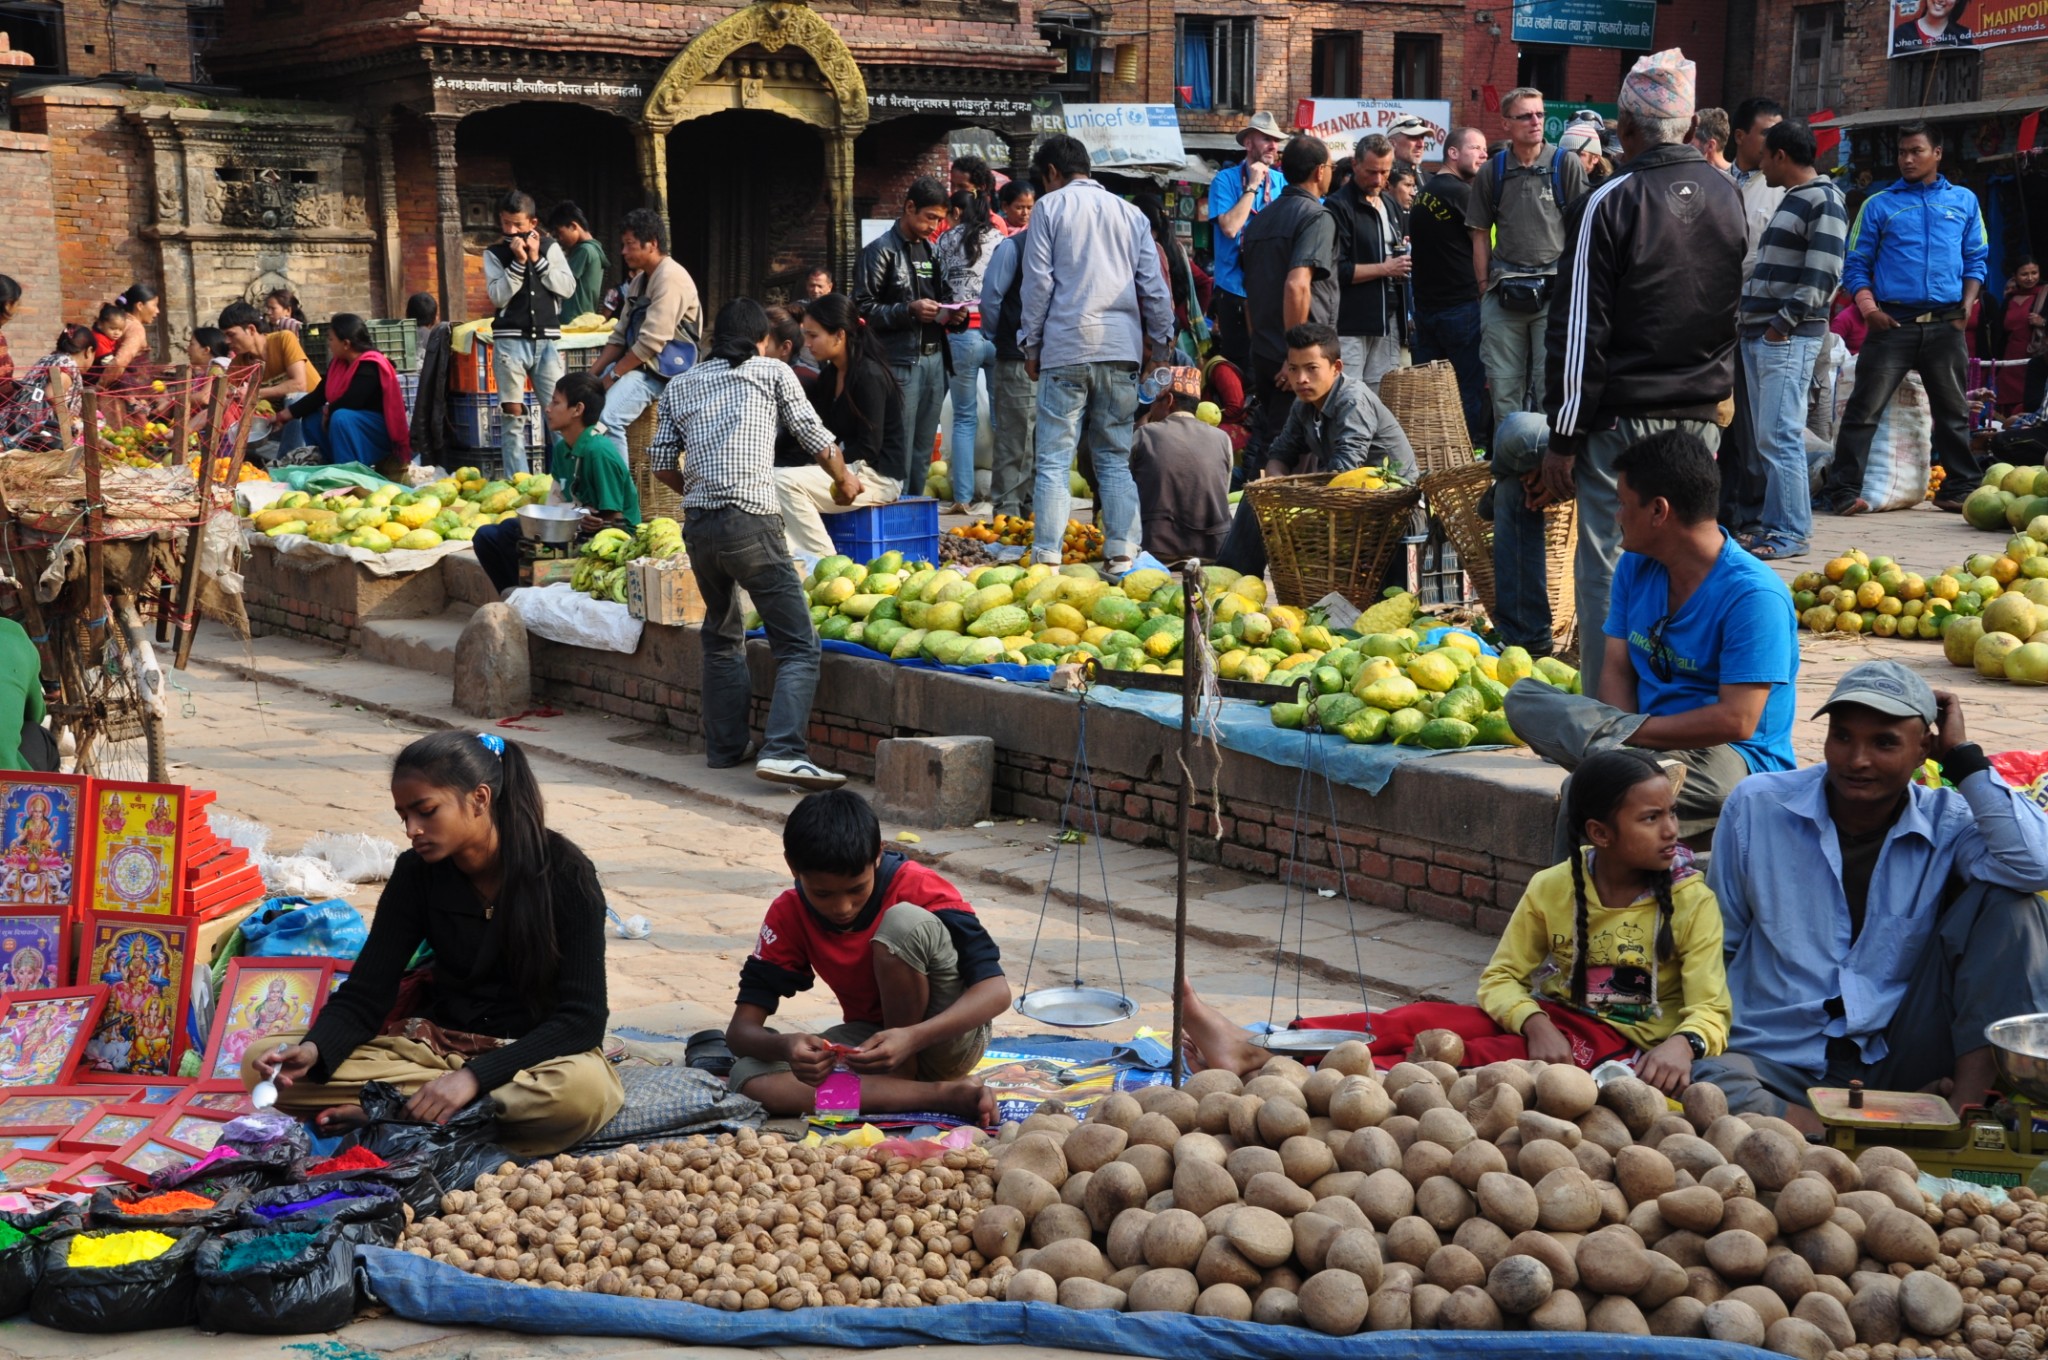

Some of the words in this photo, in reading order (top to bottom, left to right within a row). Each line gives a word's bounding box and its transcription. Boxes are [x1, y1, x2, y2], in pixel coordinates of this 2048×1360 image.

[1895, 37, 1922, 48] where
[1926, 34, 1959, 47] quality
[1960, 29, 2007, 40] education
[2010, 20, 2046, 34] stands
[1357, 101, 1402, 109] TRADITIONAL
[1066, 107, 1122, 129] unicef
